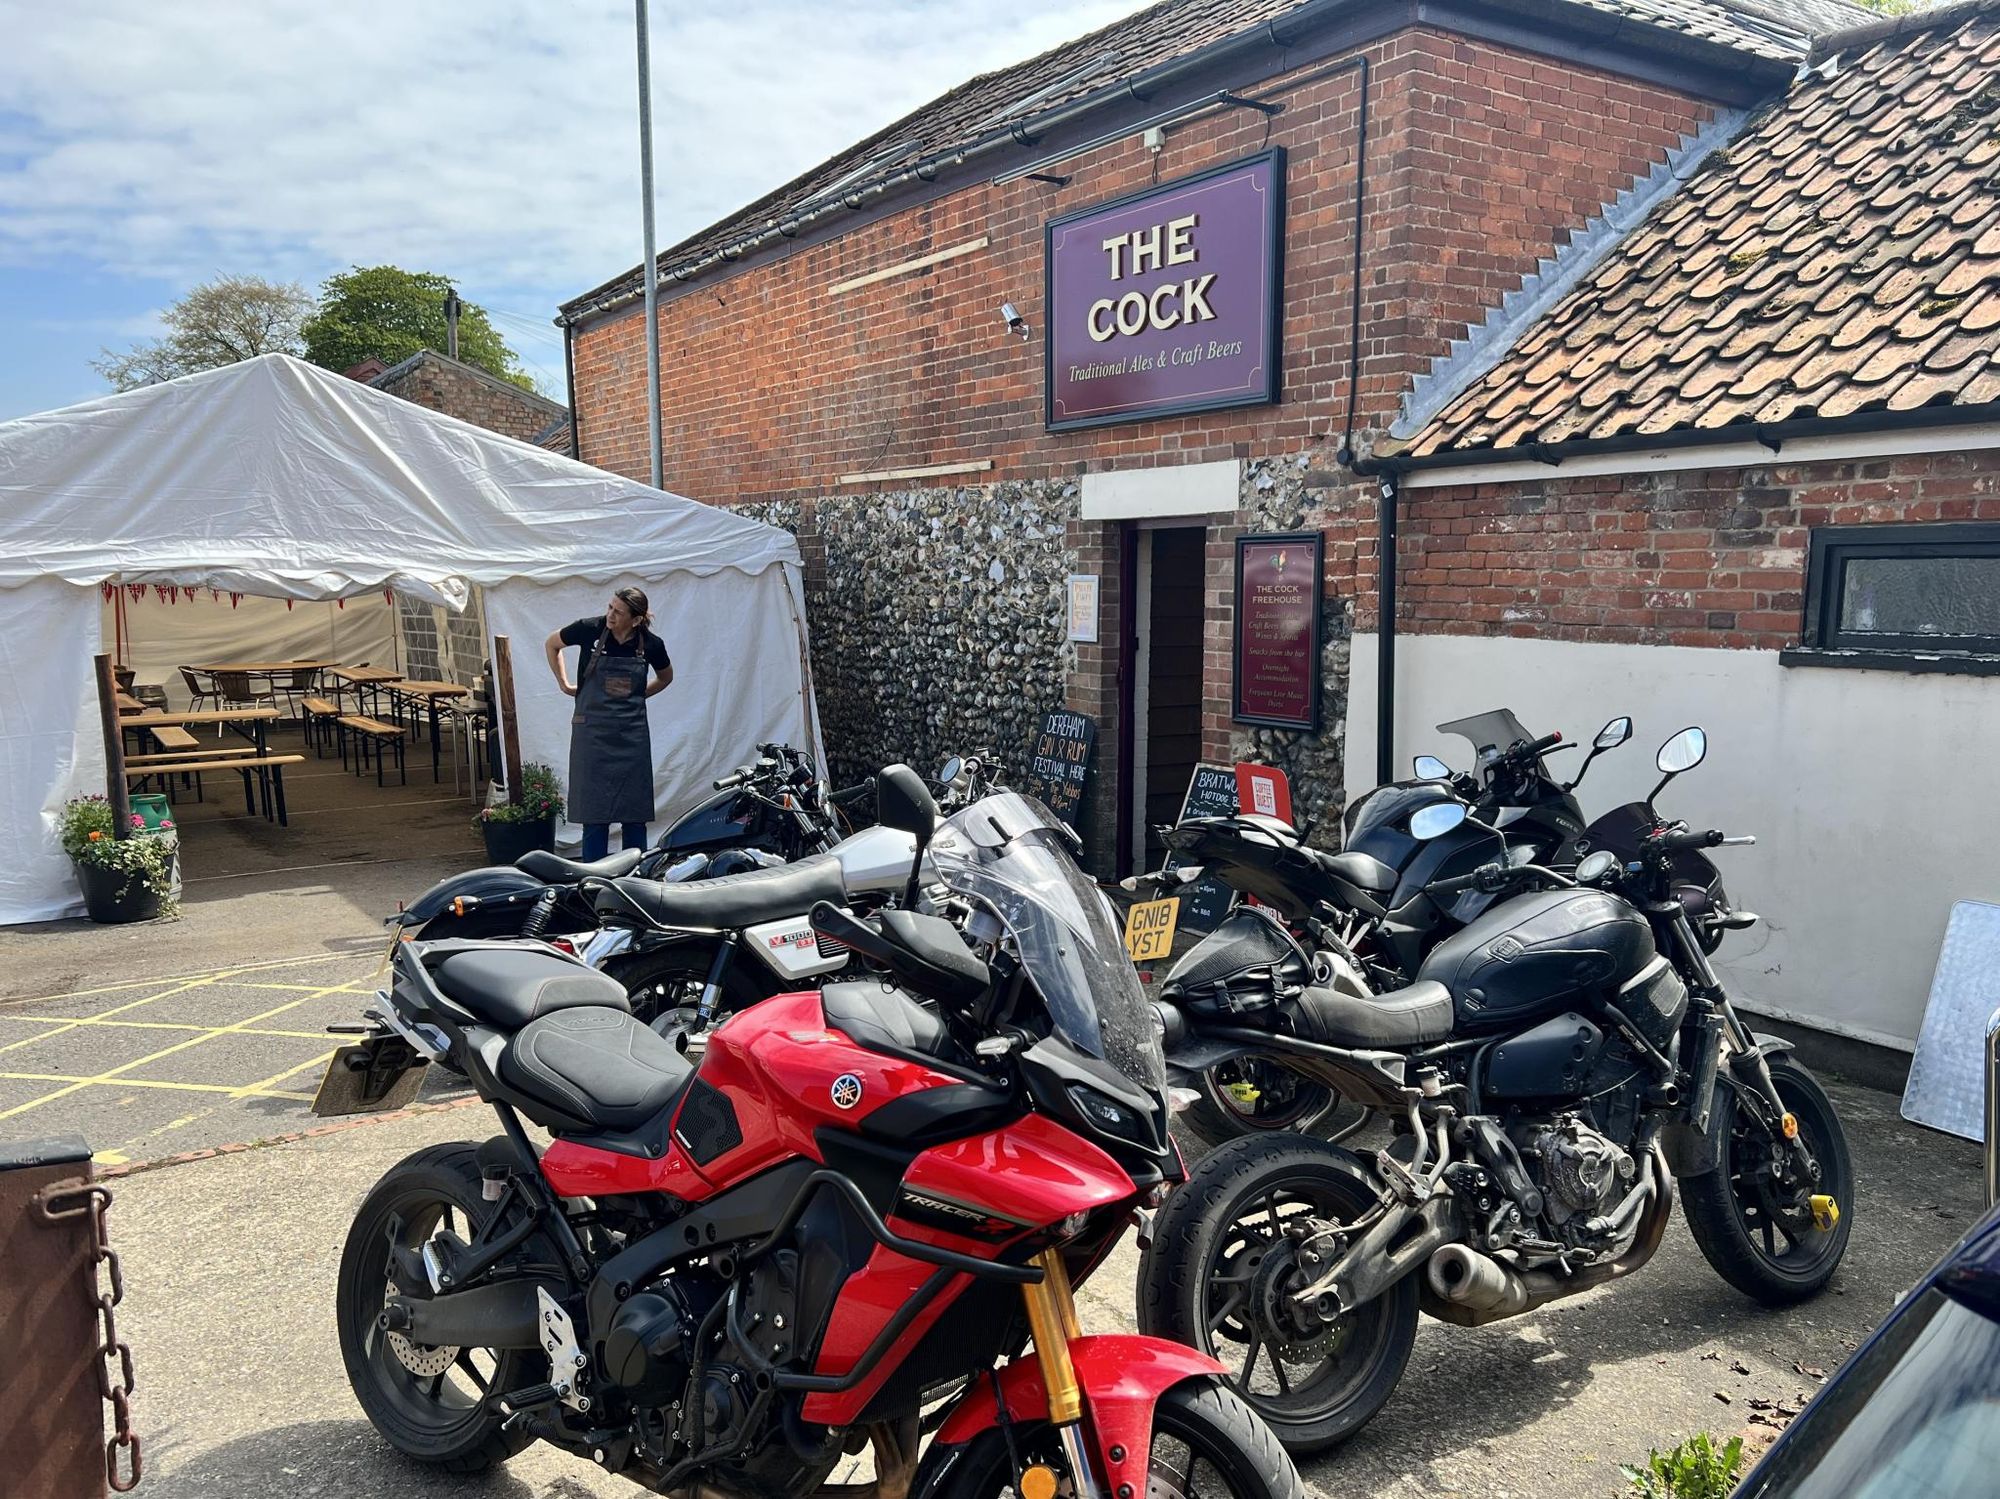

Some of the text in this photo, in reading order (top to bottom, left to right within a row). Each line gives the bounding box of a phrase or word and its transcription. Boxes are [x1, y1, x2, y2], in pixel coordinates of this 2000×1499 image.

[1102, 213, 1199, 281] THE
[1087, 273, 1218, 342] COCK
[1069, 339, 1242, 382] Traditional Ales & Craft Beers
[1252, 595, 1303, 604] FREEHOUSE
[1256, 585, 1299, 593] THE COCK
[1248, 646, 1268, 656] Snacks
[1268, 648, 1283, 657] from
[1284, 648, 1293, 657] the
[1046, 714, 1086, 739] DEREHAM
[1037, 733, 1087, 763] GIN & RUM
[1032, 756, 1065, 777] FESTIVAL
[1068, 763, 1087, 781] HERE
[1201, 789, 1229, 803] HOTDOG
[1133, 903, 1172, 932] GN18
[1131, 930, 1165, 956] YST
[904, 1192, 987, 1222] TRACER
